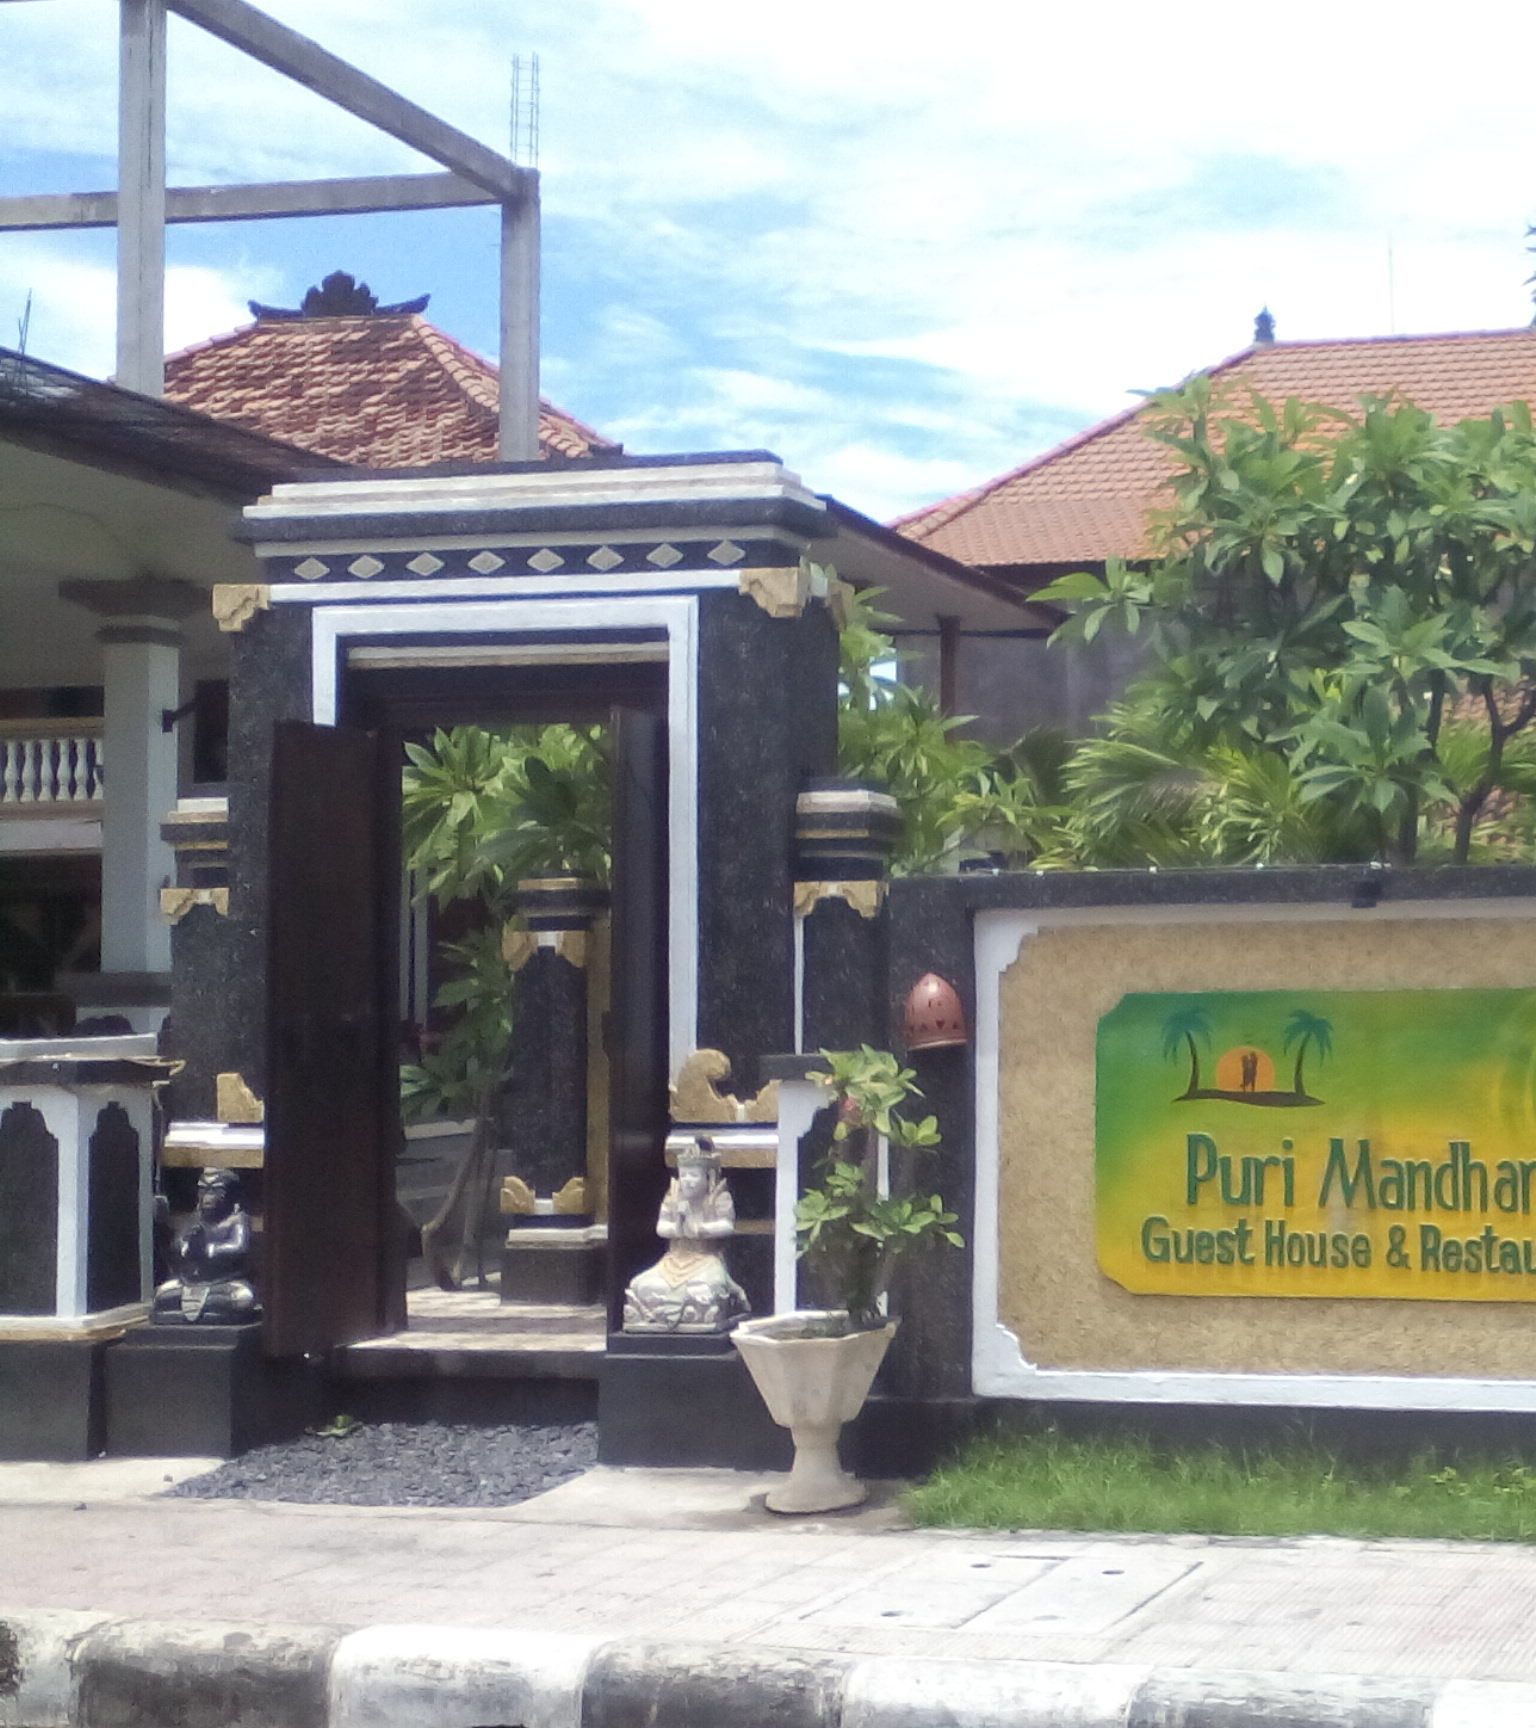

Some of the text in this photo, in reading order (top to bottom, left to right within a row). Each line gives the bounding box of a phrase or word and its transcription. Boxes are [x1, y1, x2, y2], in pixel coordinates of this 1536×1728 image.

[1186, 1131, 1296, 1207] Puri
[1141, 1216, 1255, 1266] Guest
[1264, 1219, 1372, 1269] House
[1387, 1225, 1412, 1270] &
